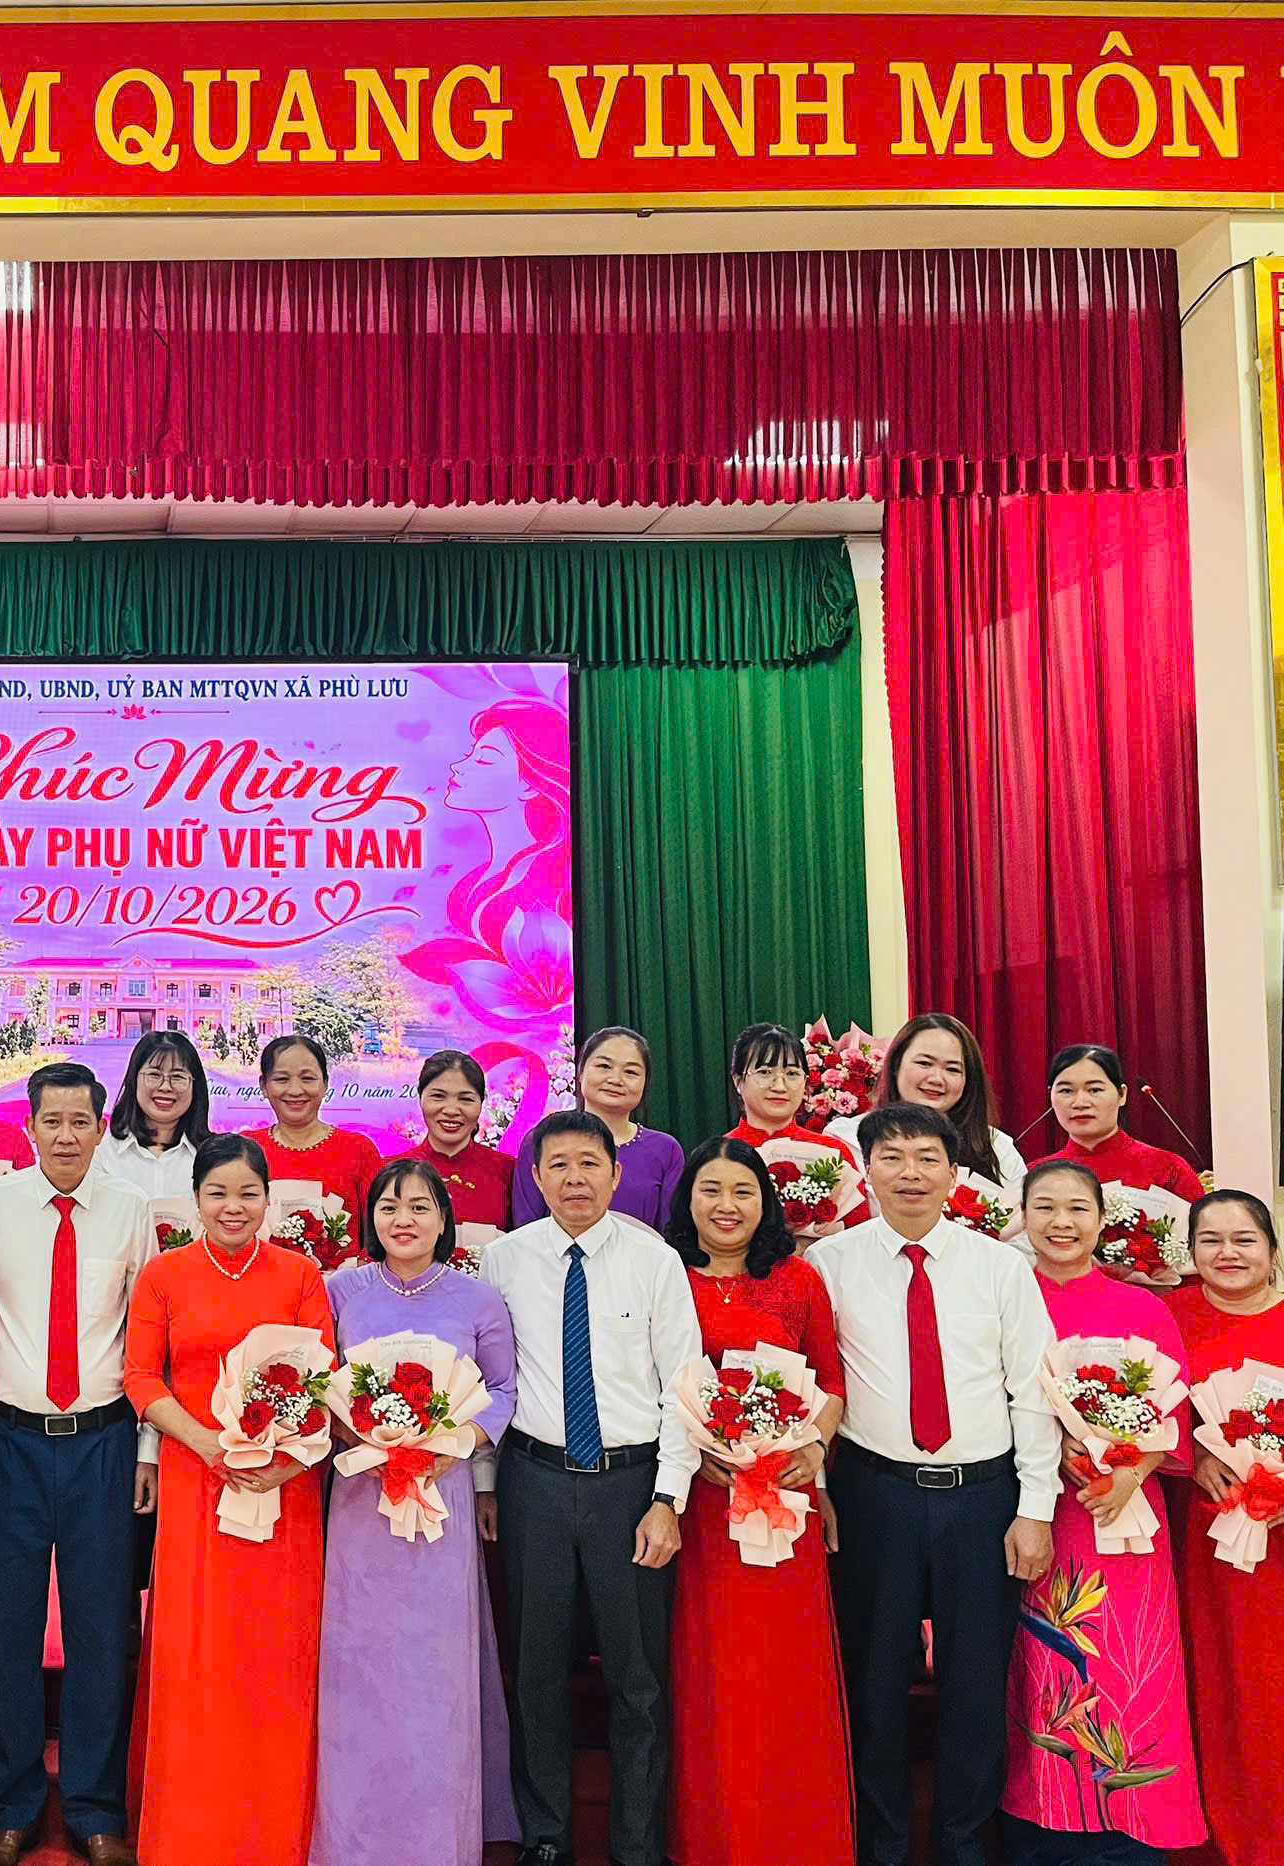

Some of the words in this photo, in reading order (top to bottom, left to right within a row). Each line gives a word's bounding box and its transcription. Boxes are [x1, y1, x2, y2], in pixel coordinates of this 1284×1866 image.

[95, 65, 513, 172] QUANG
[549, 62, 857, 159] VINH
[890, 31, 1245, 158] MUÔN
[40, 680, 100, 701] UBND,
[108, 673, 136, 698] UỶ
[142, 679, 183, 698] BAN
[190, 679, 278, 701] MTTQVN
[284, 675, 312, 698] XÃ
[319, 674, 360, 698] PHÙ
[368, 677, 409, 698] LƯU
[134, 738, 428, 824] Mừng
[47, 827, 131, 877] PHỤ
[147, 817, 209, 868] NỮ
[219, 817, 313, 878] VIỆT
[326, 828, 422, 869] NAM
[12, 884, 297, 927] 20/10/2026
[341, 1083, 359, 1098] 10
[363, 1086, 396, 1098] năm
[398, 1084, 418, 1099] 20
